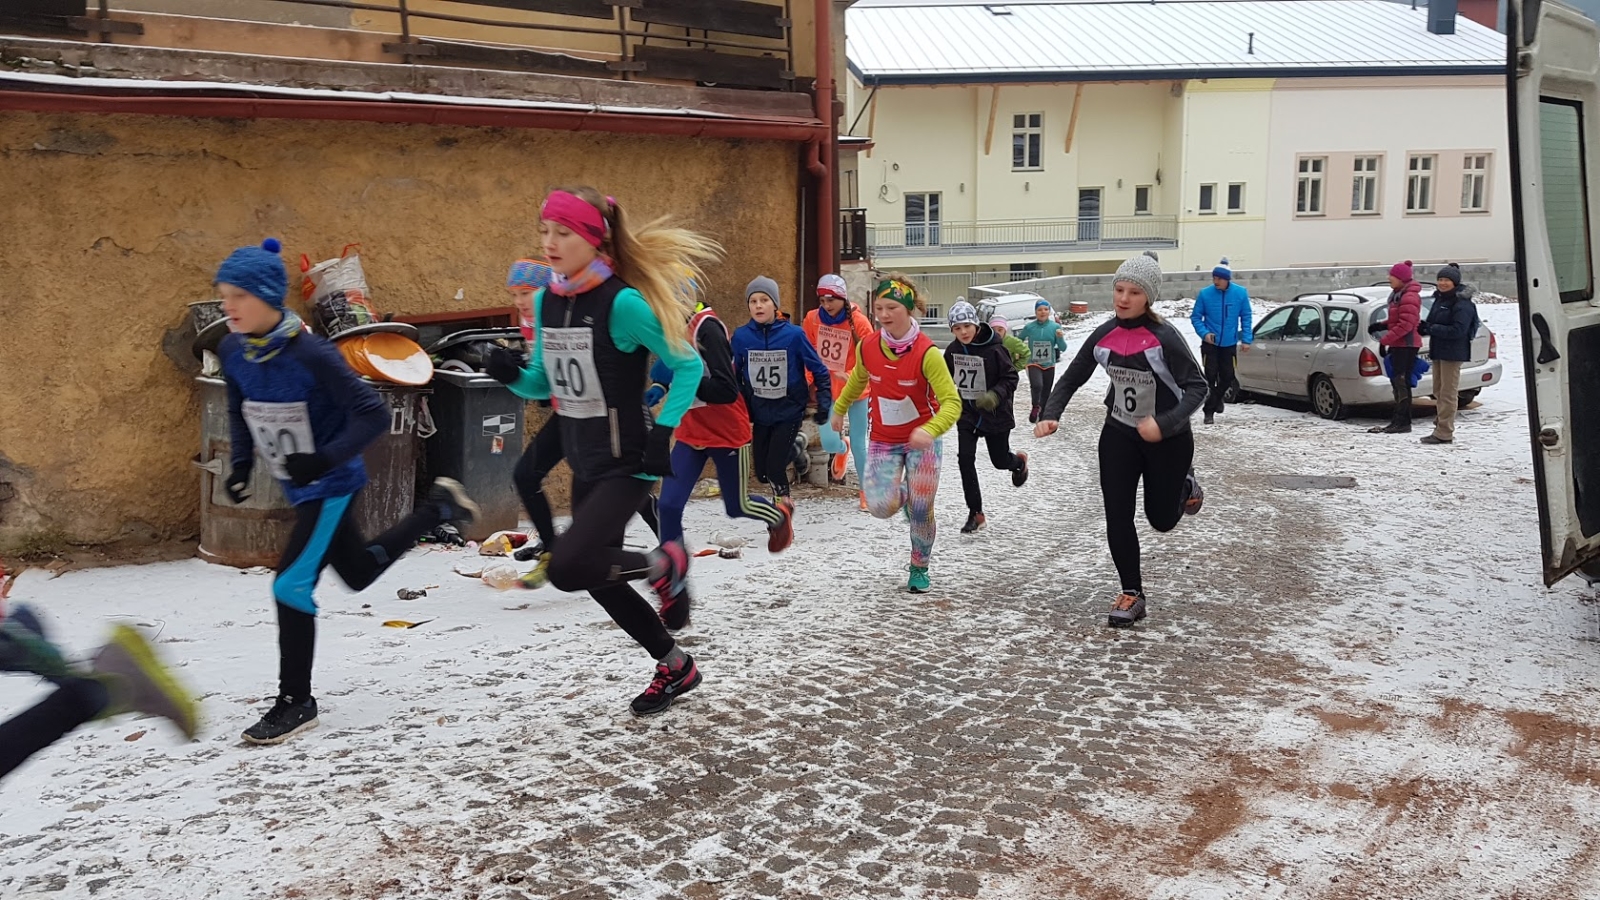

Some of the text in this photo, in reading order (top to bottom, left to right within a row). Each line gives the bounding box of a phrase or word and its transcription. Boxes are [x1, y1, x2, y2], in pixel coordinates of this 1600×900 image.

[821, 339, 842, 360] 83
[1036, 349, 1049, 359] 44
[553, 357, 584, 397] 40
[756, 366, 781, 388] 45
[959, 369, 978, 389] 27
[1124, 387, 1137, 412] 6
